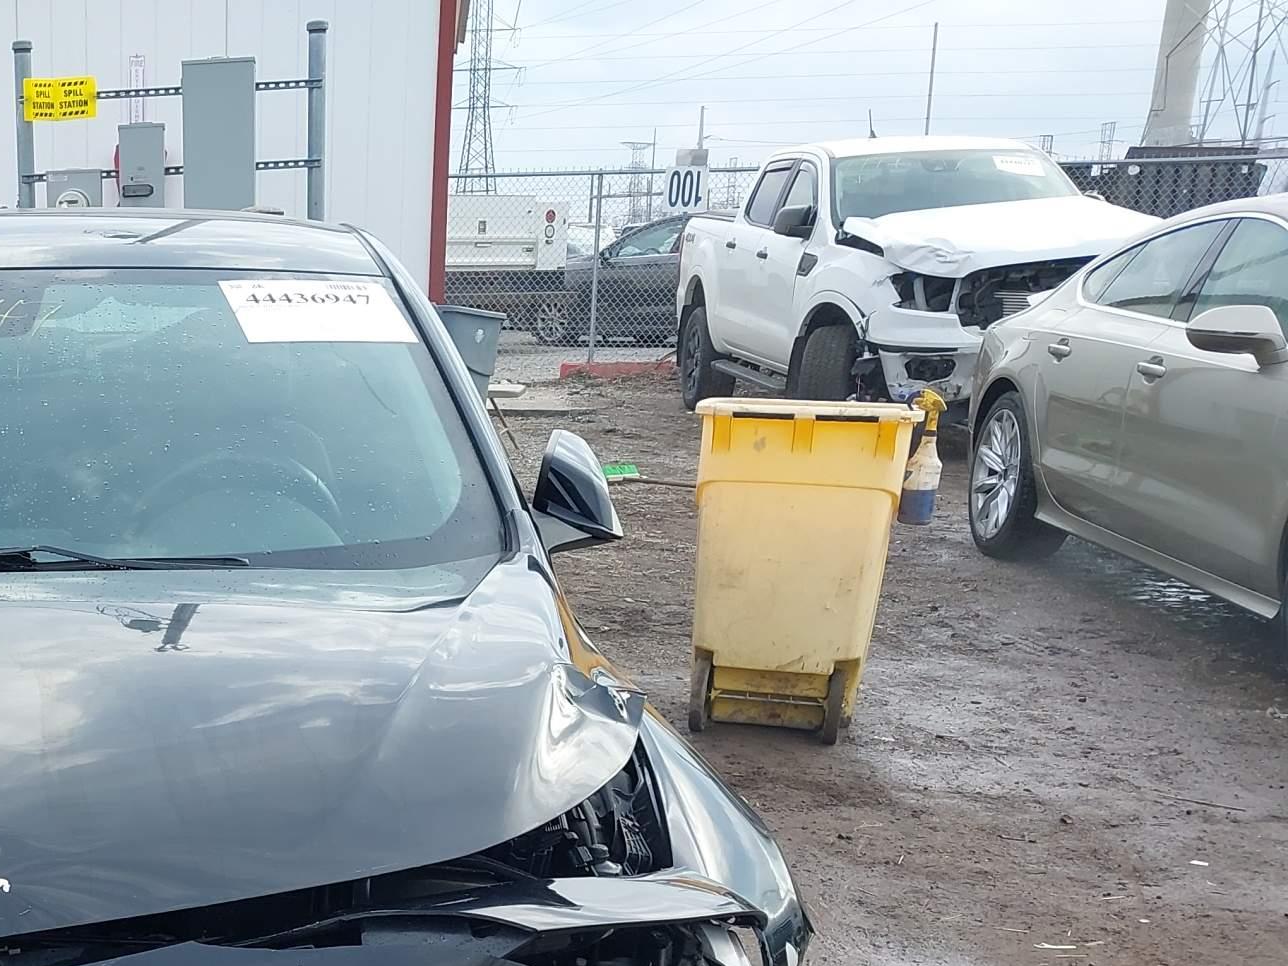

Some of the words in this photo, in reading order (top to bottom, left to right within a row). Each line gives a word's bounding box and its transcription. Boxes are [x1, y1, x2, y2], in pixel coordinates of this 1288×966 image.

[36, 91, 51, 99] SPILL
[63, 88, 84, 98] SPILL
[32, 101, 55, 110] STATION
[58, 98, 89, 110] STATION
[245, 292, 371, 305] 44436947
